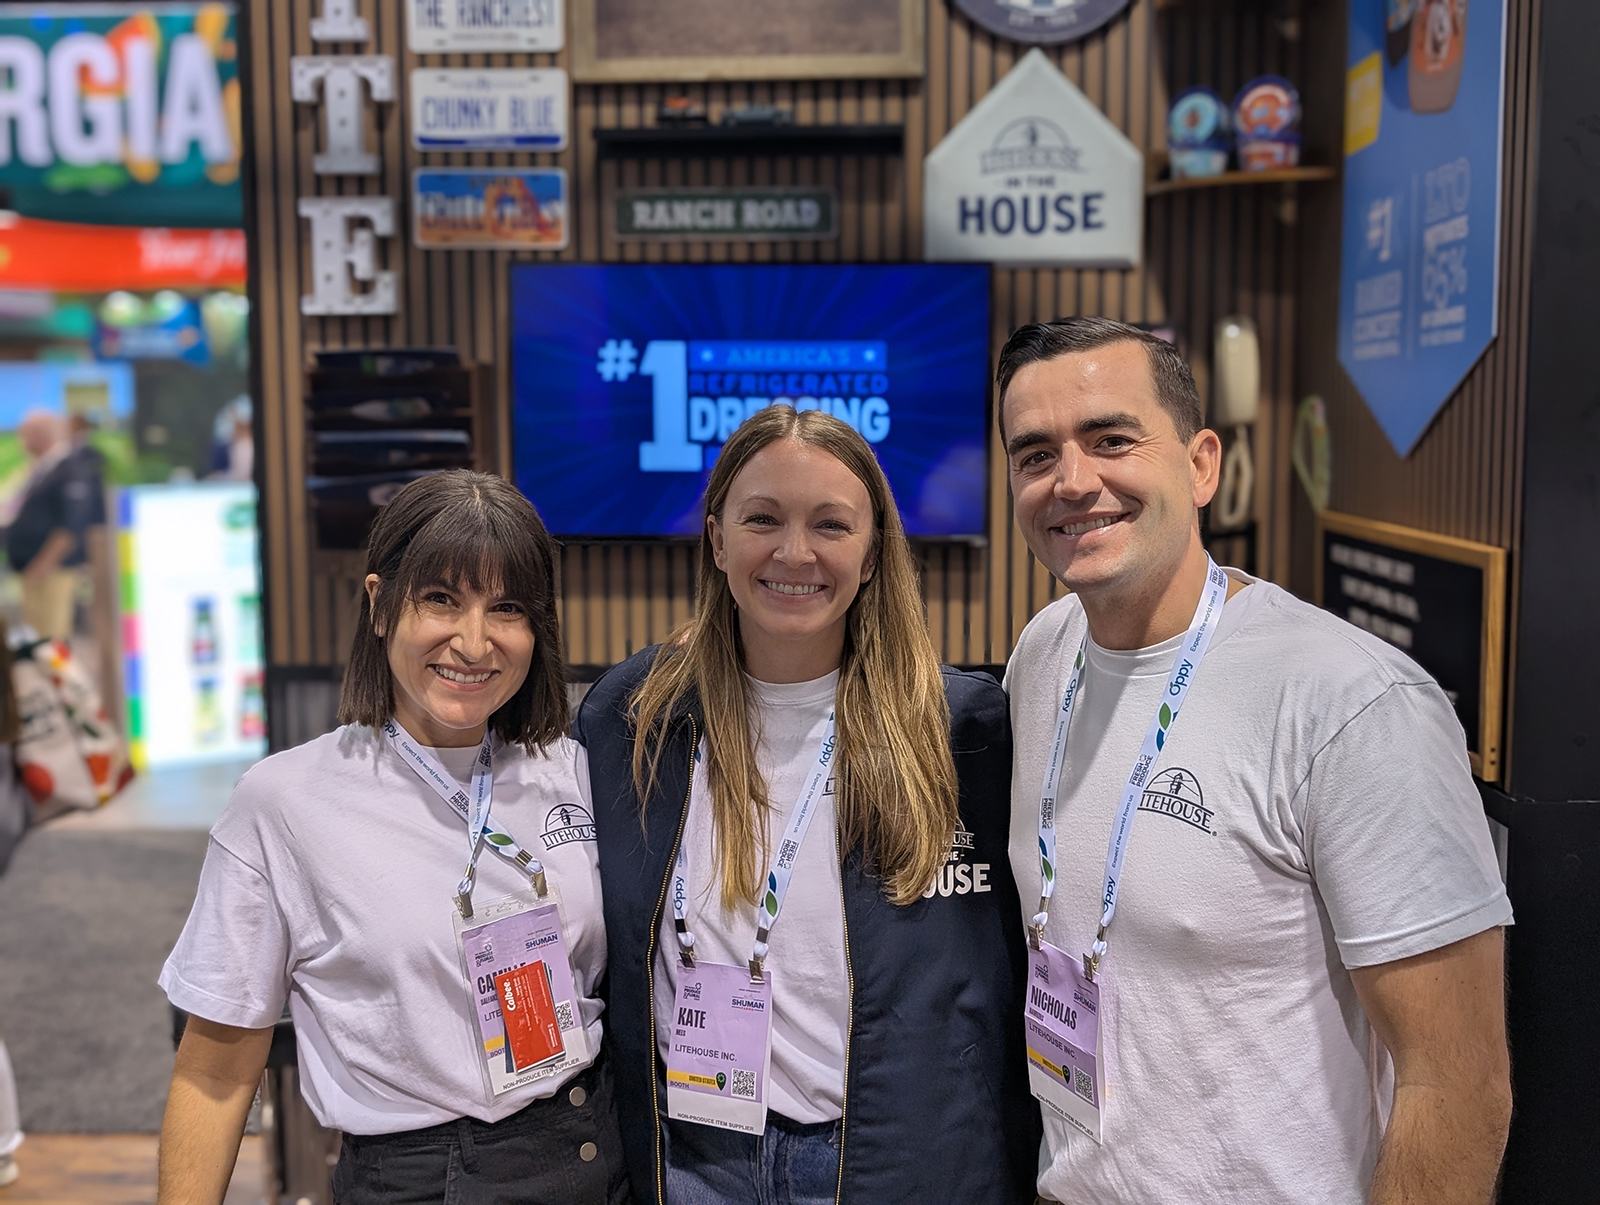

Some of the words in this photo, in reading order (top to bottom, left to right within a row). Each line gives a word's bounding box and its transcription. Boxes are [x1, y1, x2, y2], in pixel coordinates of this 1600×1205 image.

[421, 96, 498, 129] CHUNKY
[510, 94, 555, 128] BLUE
[632, 199, 736, 229] RANCH
[741, 198, 821, 228] ROAD
[958, 191, 1106, 237] HOUSE
[727, 347, 850, 366] AMERICA'S
[689, 373, 889, 395] REFRIGERATED
[596, 339, 703, 472] #1
[1208, 596, 1216, 608] from
[1204, 607, 1213, 622] world
[1199, 622, 1207, 632] the
[1190, 632, 1203, 652] Expect
[1168, 658, 1193, 696] Oppy
[402, 742, 417, 758] Expect
[416, 756, 424, 765] the
[422, 762, 436, 776] world
[434, 774, 445, 786] from
[1131, 762, 1144, 786] FRESH
[1136, 755, 1154, 787] PRODUCE
[1139, 794, 1213, 829] ITEHOUSE
[542, 826, 598, 848] LITEHOUS
[1111, 846, 1120, 868] Expect
[1119, 816, 1127, 836] world
[1123, 802, 1132, 818] from
[674, 875, 687, 910] Oppy
[525, 934, 558, 949] SHUMAN
[504, 981, 517, 1011] Calbee
[732, 998, 765, 1009] SHUMAN
[1030, 984, 1078, 1030] NICHOLAS
[1074, 992, 1097, 1013] SHUMAN
[484, 1010, 504, 1022] LITE
[678, 1006, 707, 1029] KATE
[1028, 1022, 1063, 1051] LITEHOUSE
[490, 1048, 506, 1058] BOOT
[674, 1044, 719, 1059] LITEHOUSE
[720, 1052, 738, 1062] INC.
[502, 1072, 541, 1090] NON-PRODUCE
[541, 1066, 554, 1076] ITEM
[554, 1057, 580, 1072] SUPPLIER
[670, 1080, 690, 1089] BOOTH
[677, 1112, 715, 1125] NON-PRODUCE
[715, 1119, 728, 1127] ITEM
[728, 1122, 755, 1132] SUPPLIER
